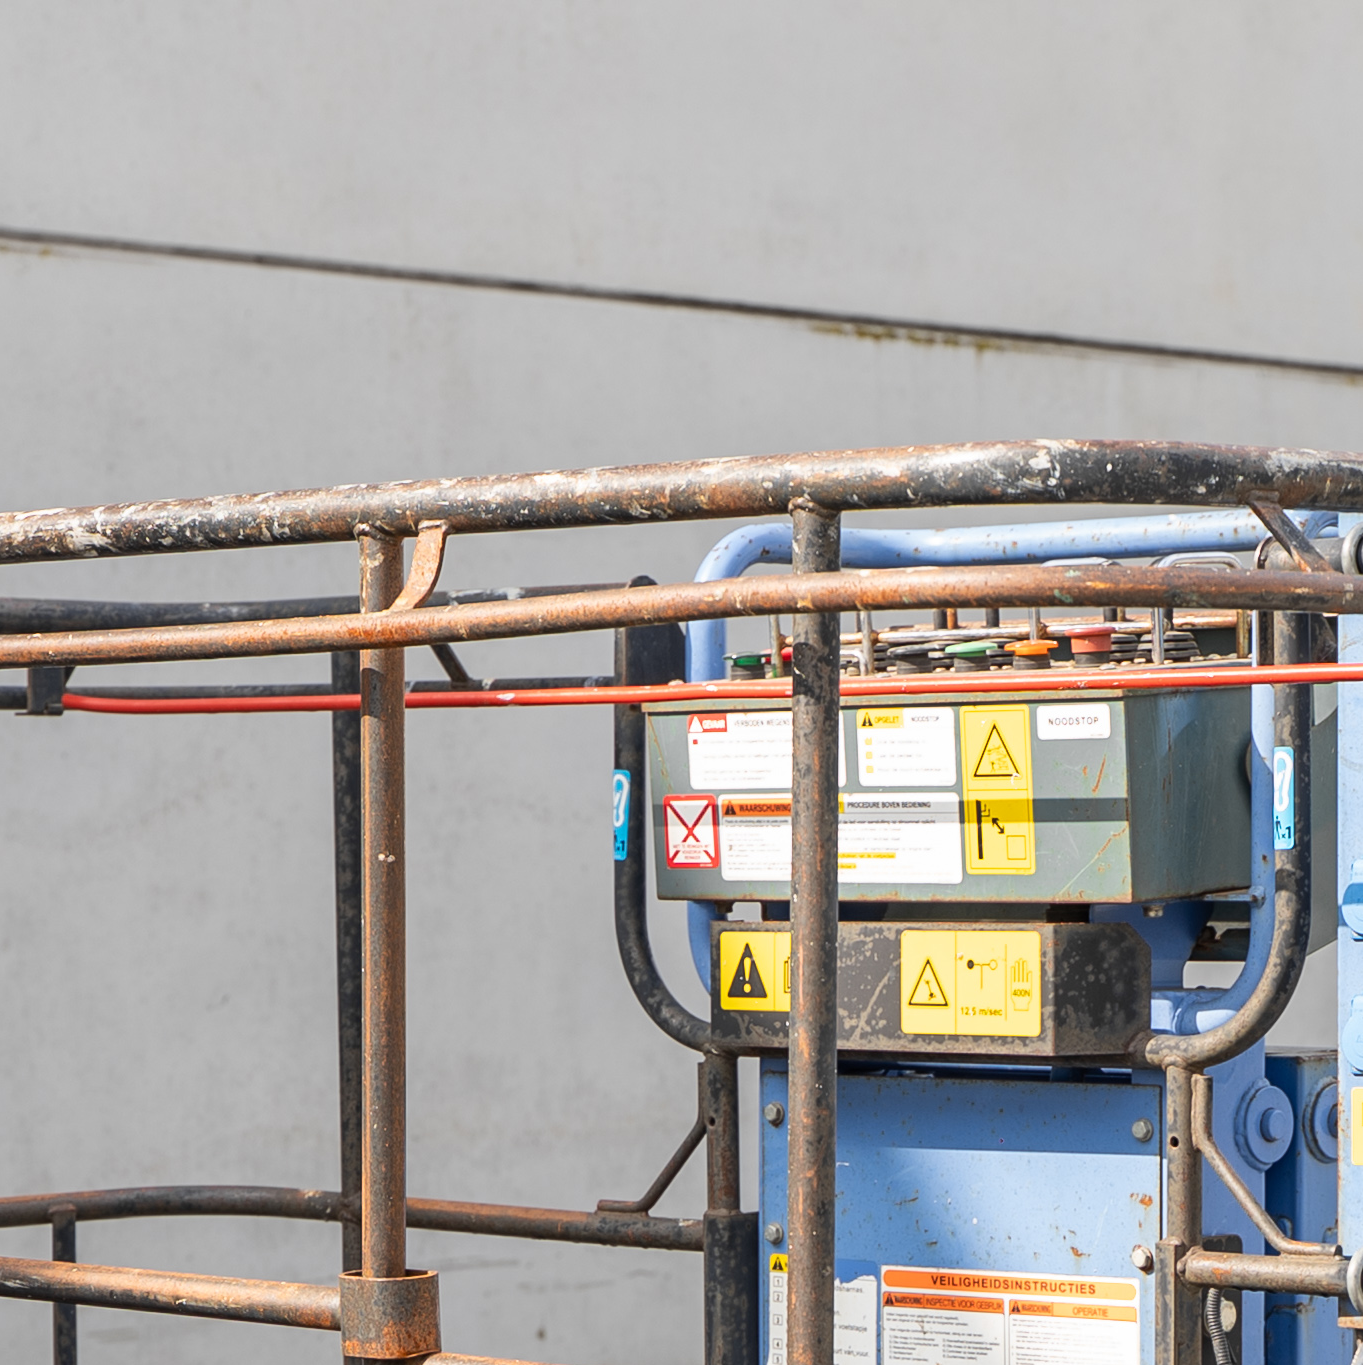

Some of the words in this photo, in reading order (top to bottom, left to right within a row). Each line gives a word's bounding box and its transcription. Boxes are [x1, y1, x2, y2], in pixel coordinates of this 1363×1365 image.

[1048, 716, 1099, 726] NOODSTOP
[847, 801, 880, 809] PROCEDURE
[881, 801, 901, 809] BOVEN
[1012, 989, 1031, 997] 400N
[960, 1007, 976, 1016] 125
[931, 1275, 1096, 1295] VEILIGHEIDSINSTRUCTIES
[926, 1298, 956, 1307] INSPECTIE
[957, 1300, 975, 1309] VOOR
[1072, 1306, 1109, 1318] OPERATIE
